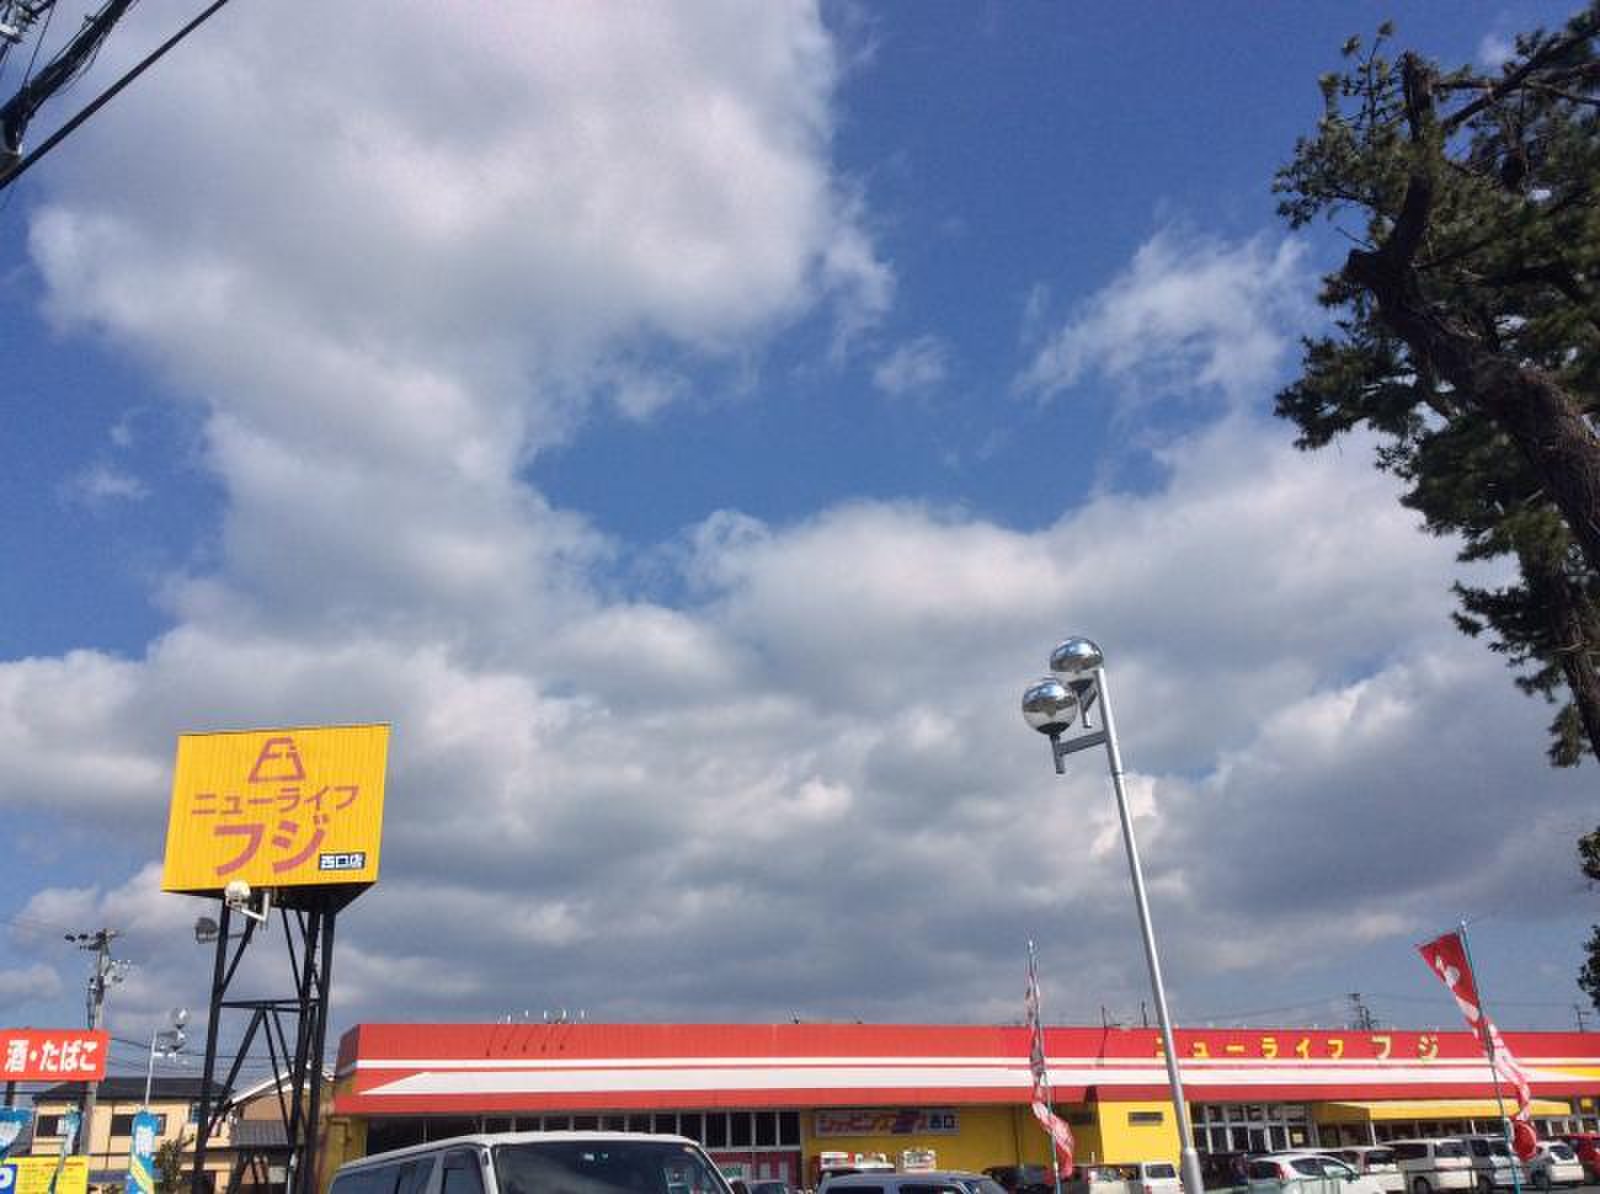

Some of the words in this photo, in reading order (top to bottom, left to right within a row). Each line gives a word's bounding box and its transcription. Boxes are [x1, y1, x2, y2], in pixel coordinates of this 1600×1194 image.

[192, 785, 360, 816] ニューライフ
[214, 814, 329, 876] フジ
[4, 1039, 97, 1073] 酒・たばこ
[1371, 1035, 1439, 1060] フジ
